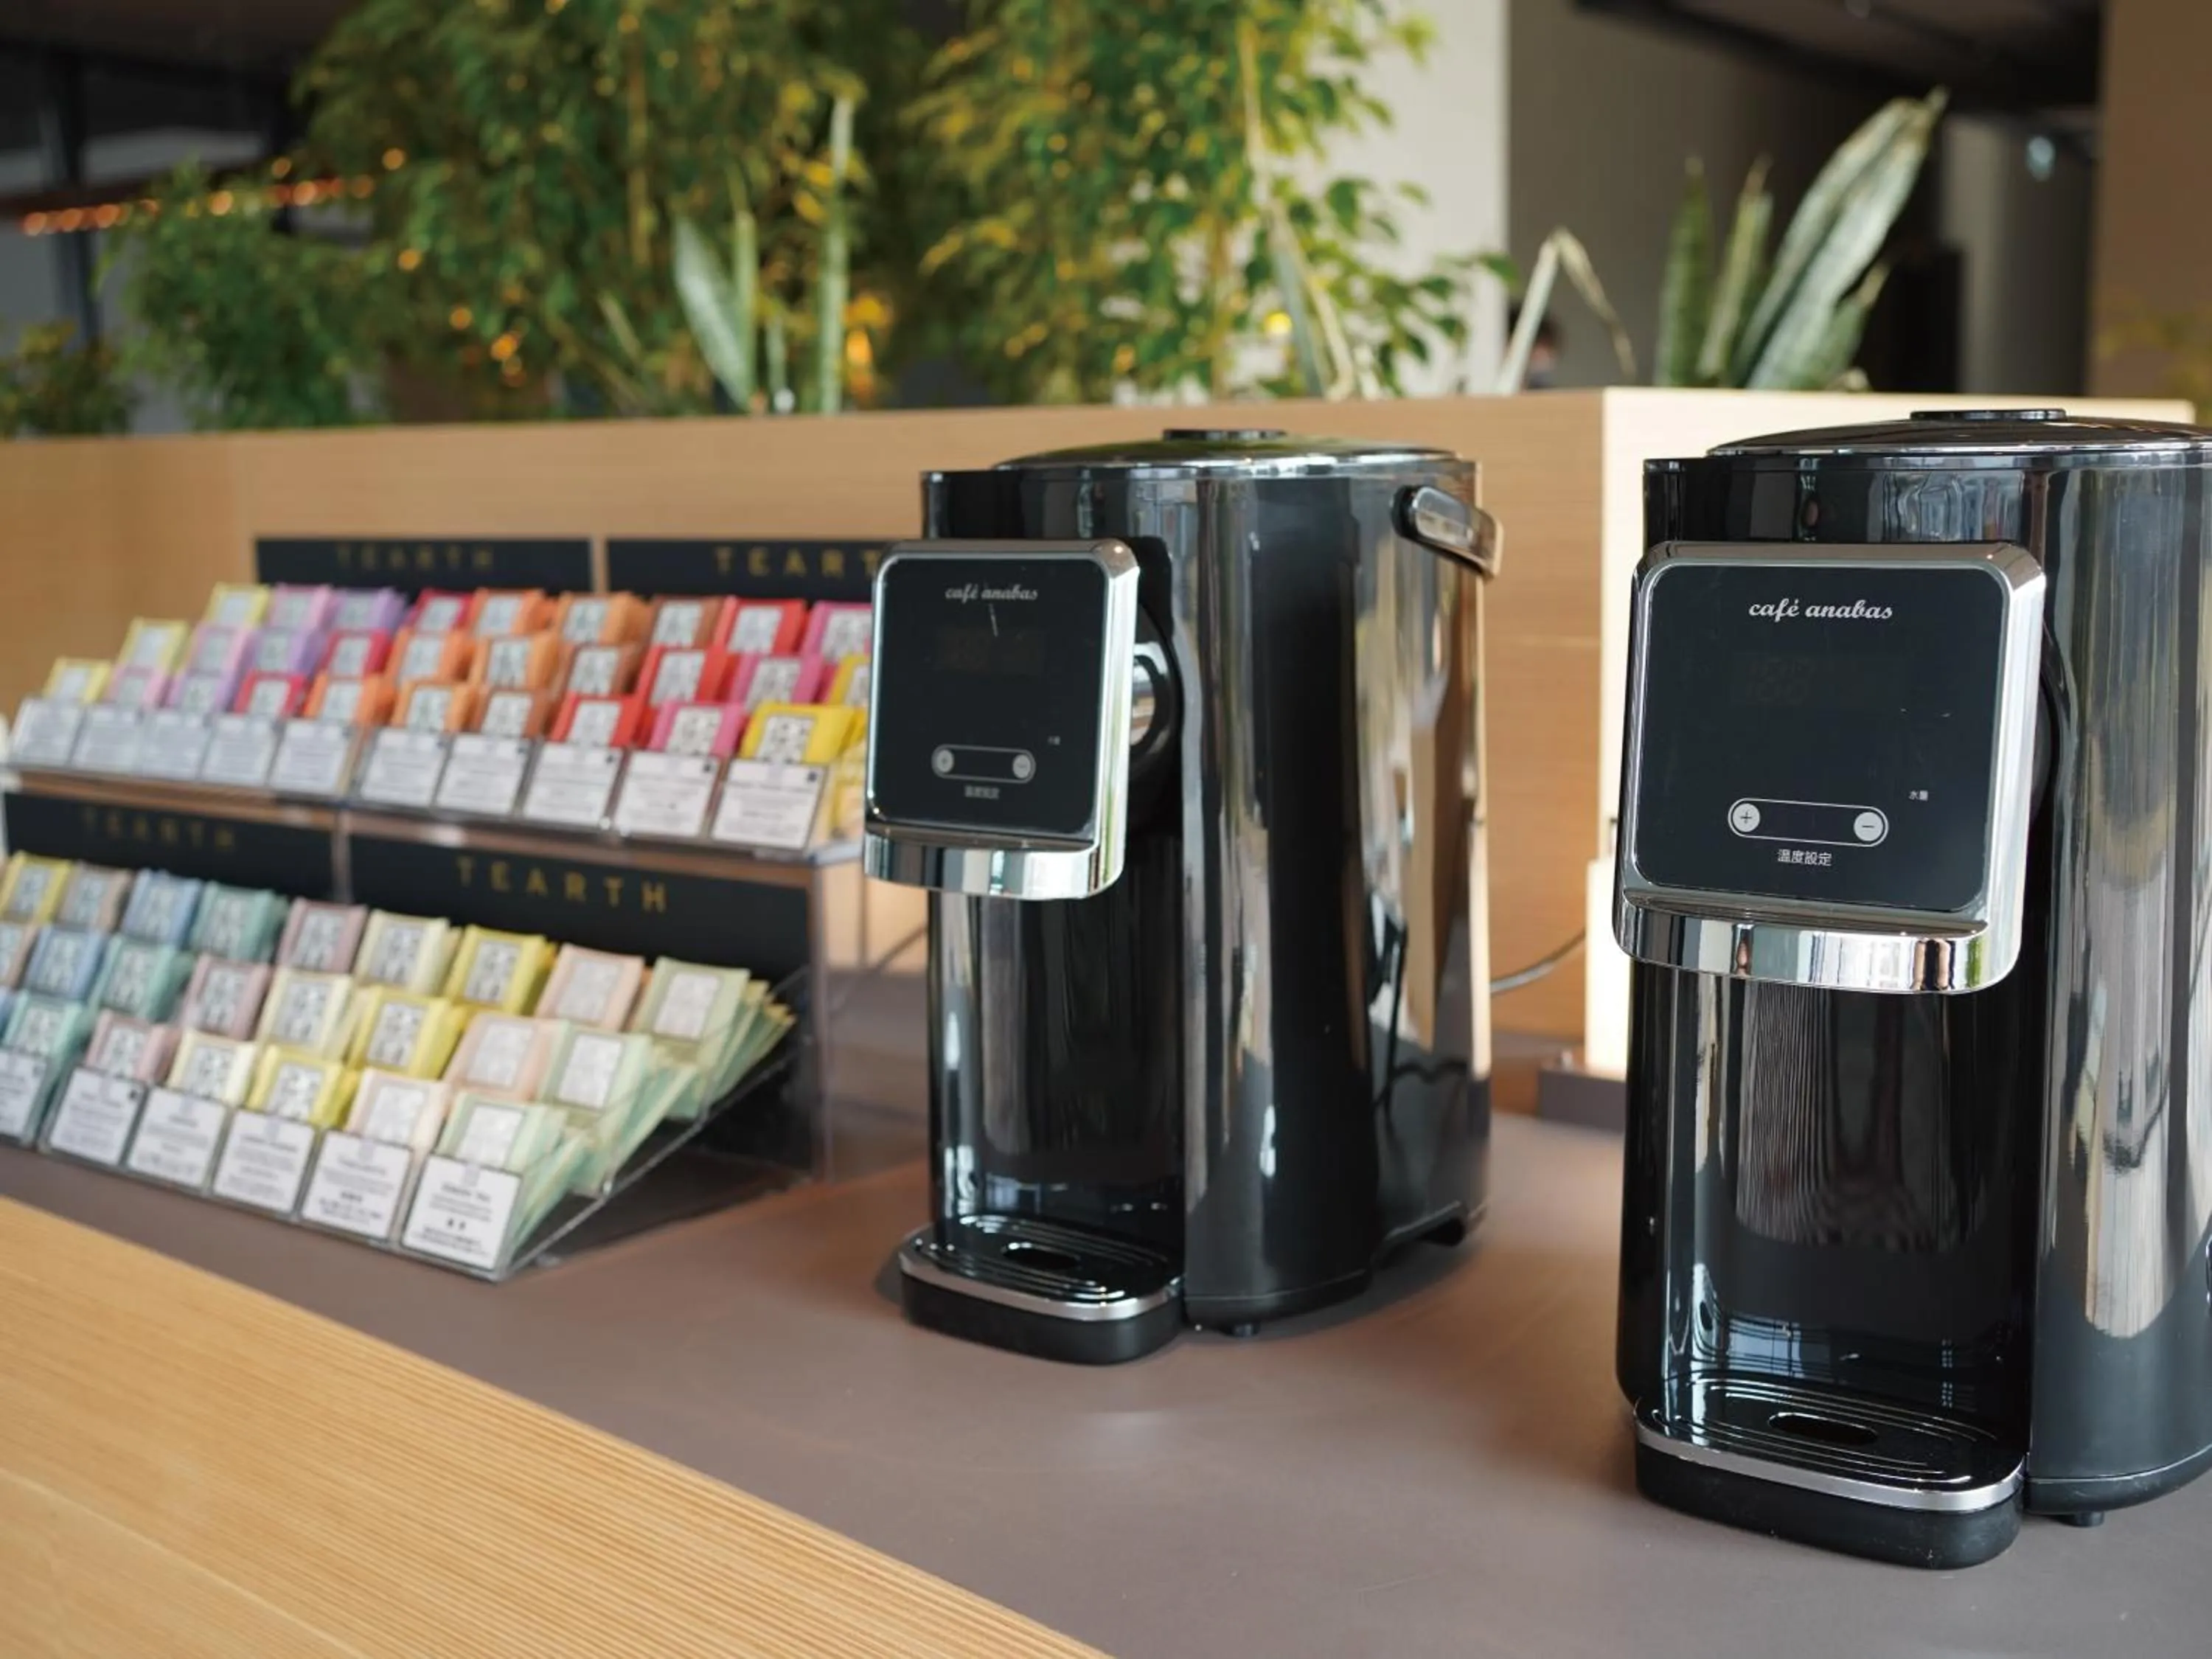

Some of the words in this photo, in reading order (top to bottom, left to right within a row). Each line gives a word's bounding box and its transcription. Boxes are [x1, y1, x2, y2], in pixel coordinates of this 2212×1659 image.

[713, 546, 882, 577] TEART
[1748, 598, 1800, 622] café
[1805, 599, 1893, 619] anabas
[456, 855, 667, 913] TEARTH
